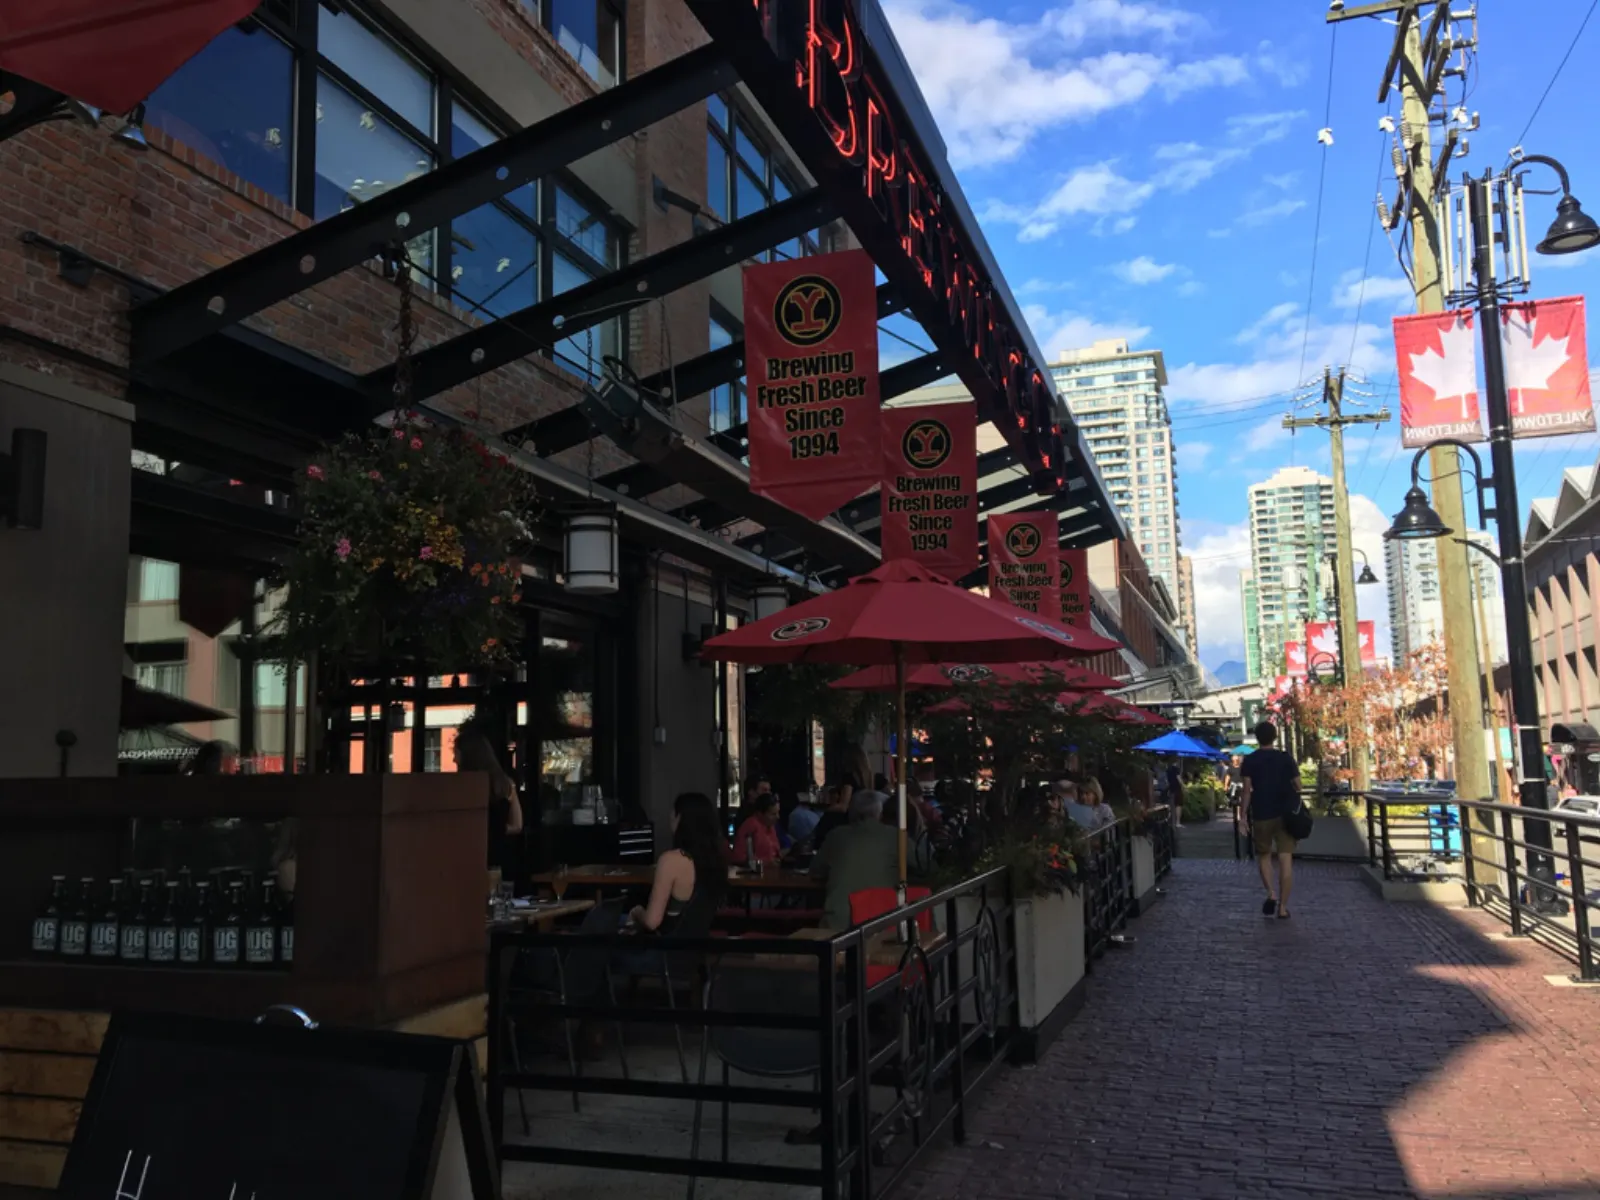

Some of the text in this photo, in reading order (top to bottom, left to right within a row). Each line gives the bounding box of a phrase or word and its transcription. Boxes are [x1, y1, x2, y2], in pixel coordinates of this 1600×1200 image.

[767, 352, 854, 380] Brewing
[757, 376, 866, 408] Fresh Beer
[785, 407, 844, 432] Since
[789, 432, 839, 459] 1994
[896, 474, 960, 492] Brewing
[889, 494, 969, 512] Fresh Beer
[909, 514, 952, 531] Since
[911, 533, 948, 551] 1994
[1001, 563, 1047, 574] Brewing
[994, 575, 1053, 587] Fresh Beer
[1009, 590, 1040, 601] Since
